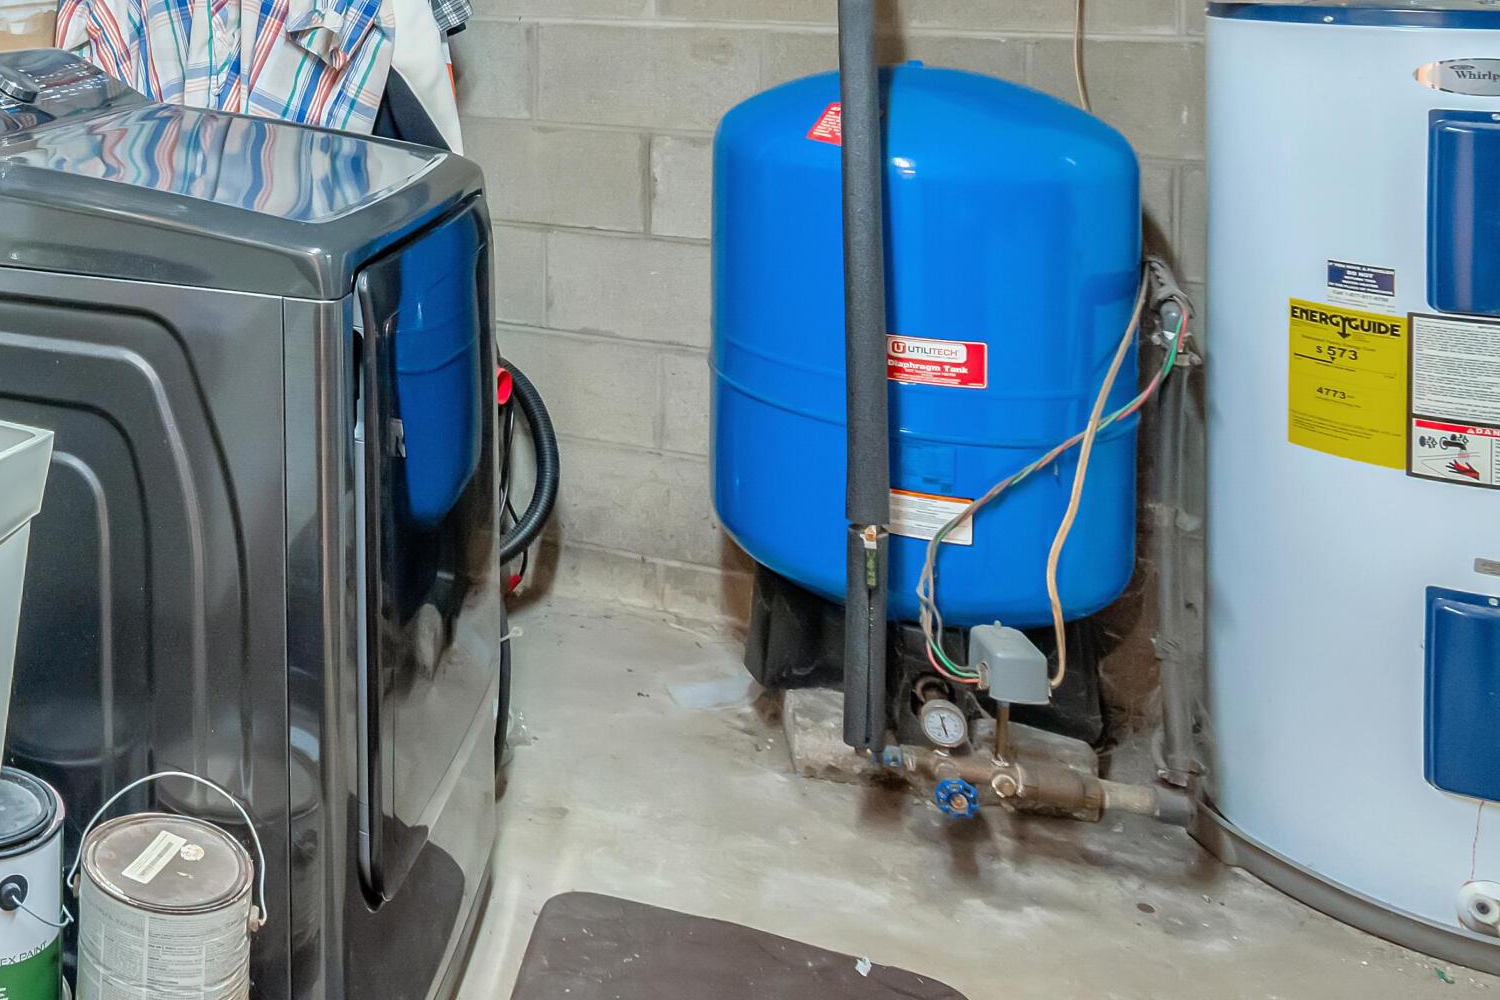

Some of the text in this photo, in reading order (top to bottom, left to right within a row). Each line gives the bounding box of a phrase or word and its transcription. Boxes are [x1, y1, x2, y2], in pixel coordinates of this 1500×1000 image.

[1290, 305, 1401, 338] ENERGYGUIDE
[907, 345, 958, 357] UTILITECH
[1327, 345, 1358, 361] 573
[887, 359, 941, 372] Diaphragm
[943, 364, 969, 374] Tank
[1316, 386, 1347, 400] 4773
[19, 940, 48, 963] PAINT
